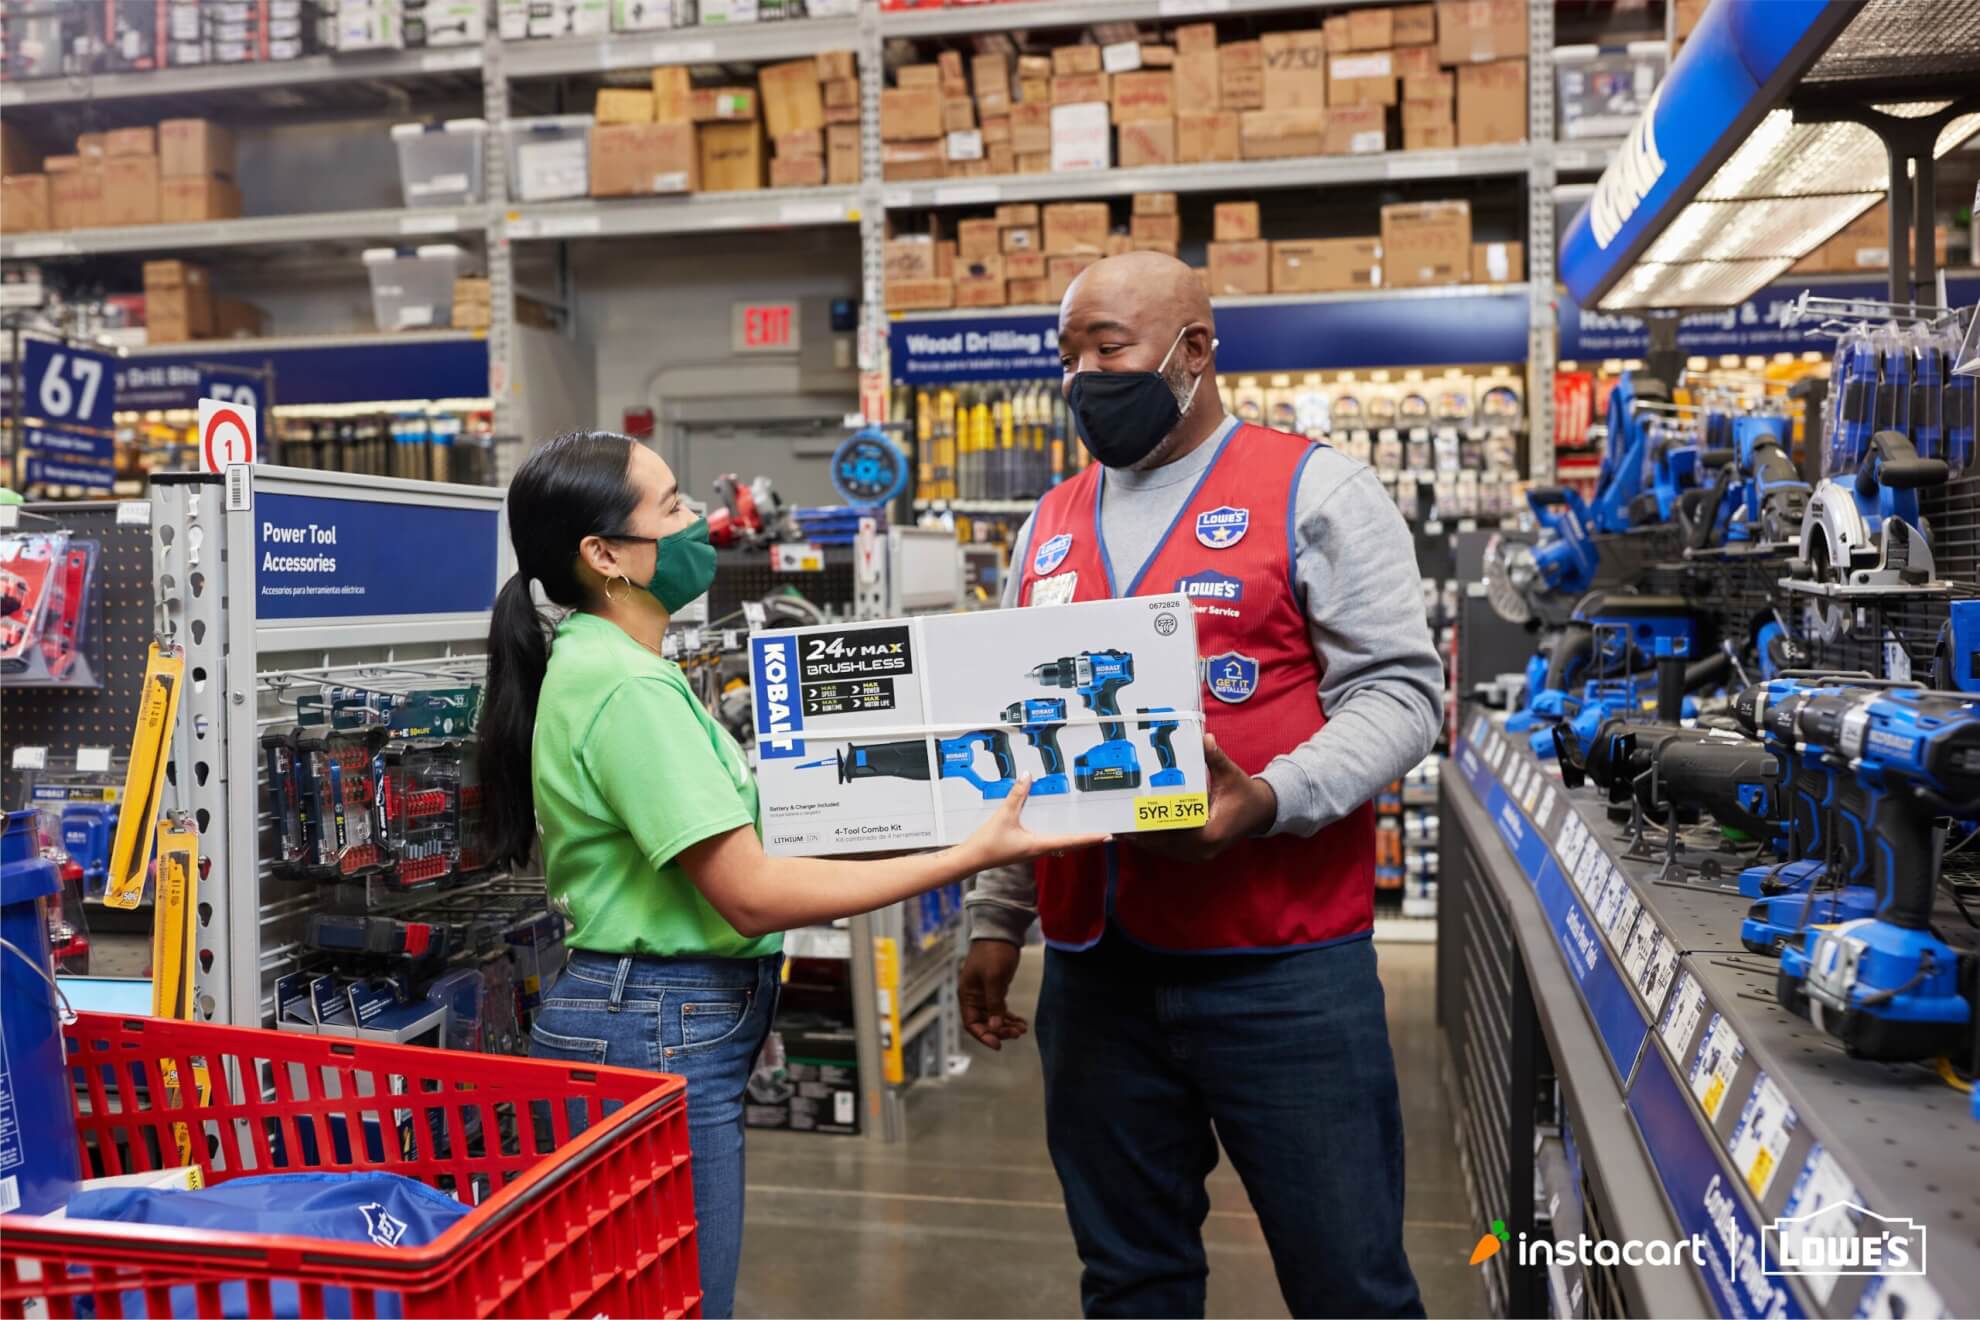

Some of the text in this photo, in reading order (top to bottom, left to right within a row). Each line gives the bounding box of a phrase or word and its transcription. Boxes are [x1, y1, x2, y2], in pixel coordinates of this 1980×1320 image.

[744, 306, 790, 346] EXIT
[906, 332, 963, 354] Wood
[965, 331, 1041, 354] Drilling
[40, 354, 103, 420] 67
[225, 440, 233, 461] 1
[1203, 512, 1243, 524] LOWE'S
[263, 522, 337, 545] Power Tool
[262, 552, 337, 573] Accessories
[262, 586, 292, 596] Accesorios
[293, 587, 306, 597] para
[306, 585, 340, 595] herramientas
[1180, 581, 1236, 597] LOWE'S
[1208, 606, 1240, 617] Service
[861, 643, 904, 656] MAX
[807, 658, 905, 675] BRUSHLESS
[1216, 679, 1249, 688] GET IT
[763, 643, 793, 752] KOBALT
[1139, 806, 1168, 820] 5YR
[1175, 803, 1204, 817] 3YR
[834, 824, 902, 836] 4-Tool Combo Kit
[774, 836, 803, 844] LITHIUM
